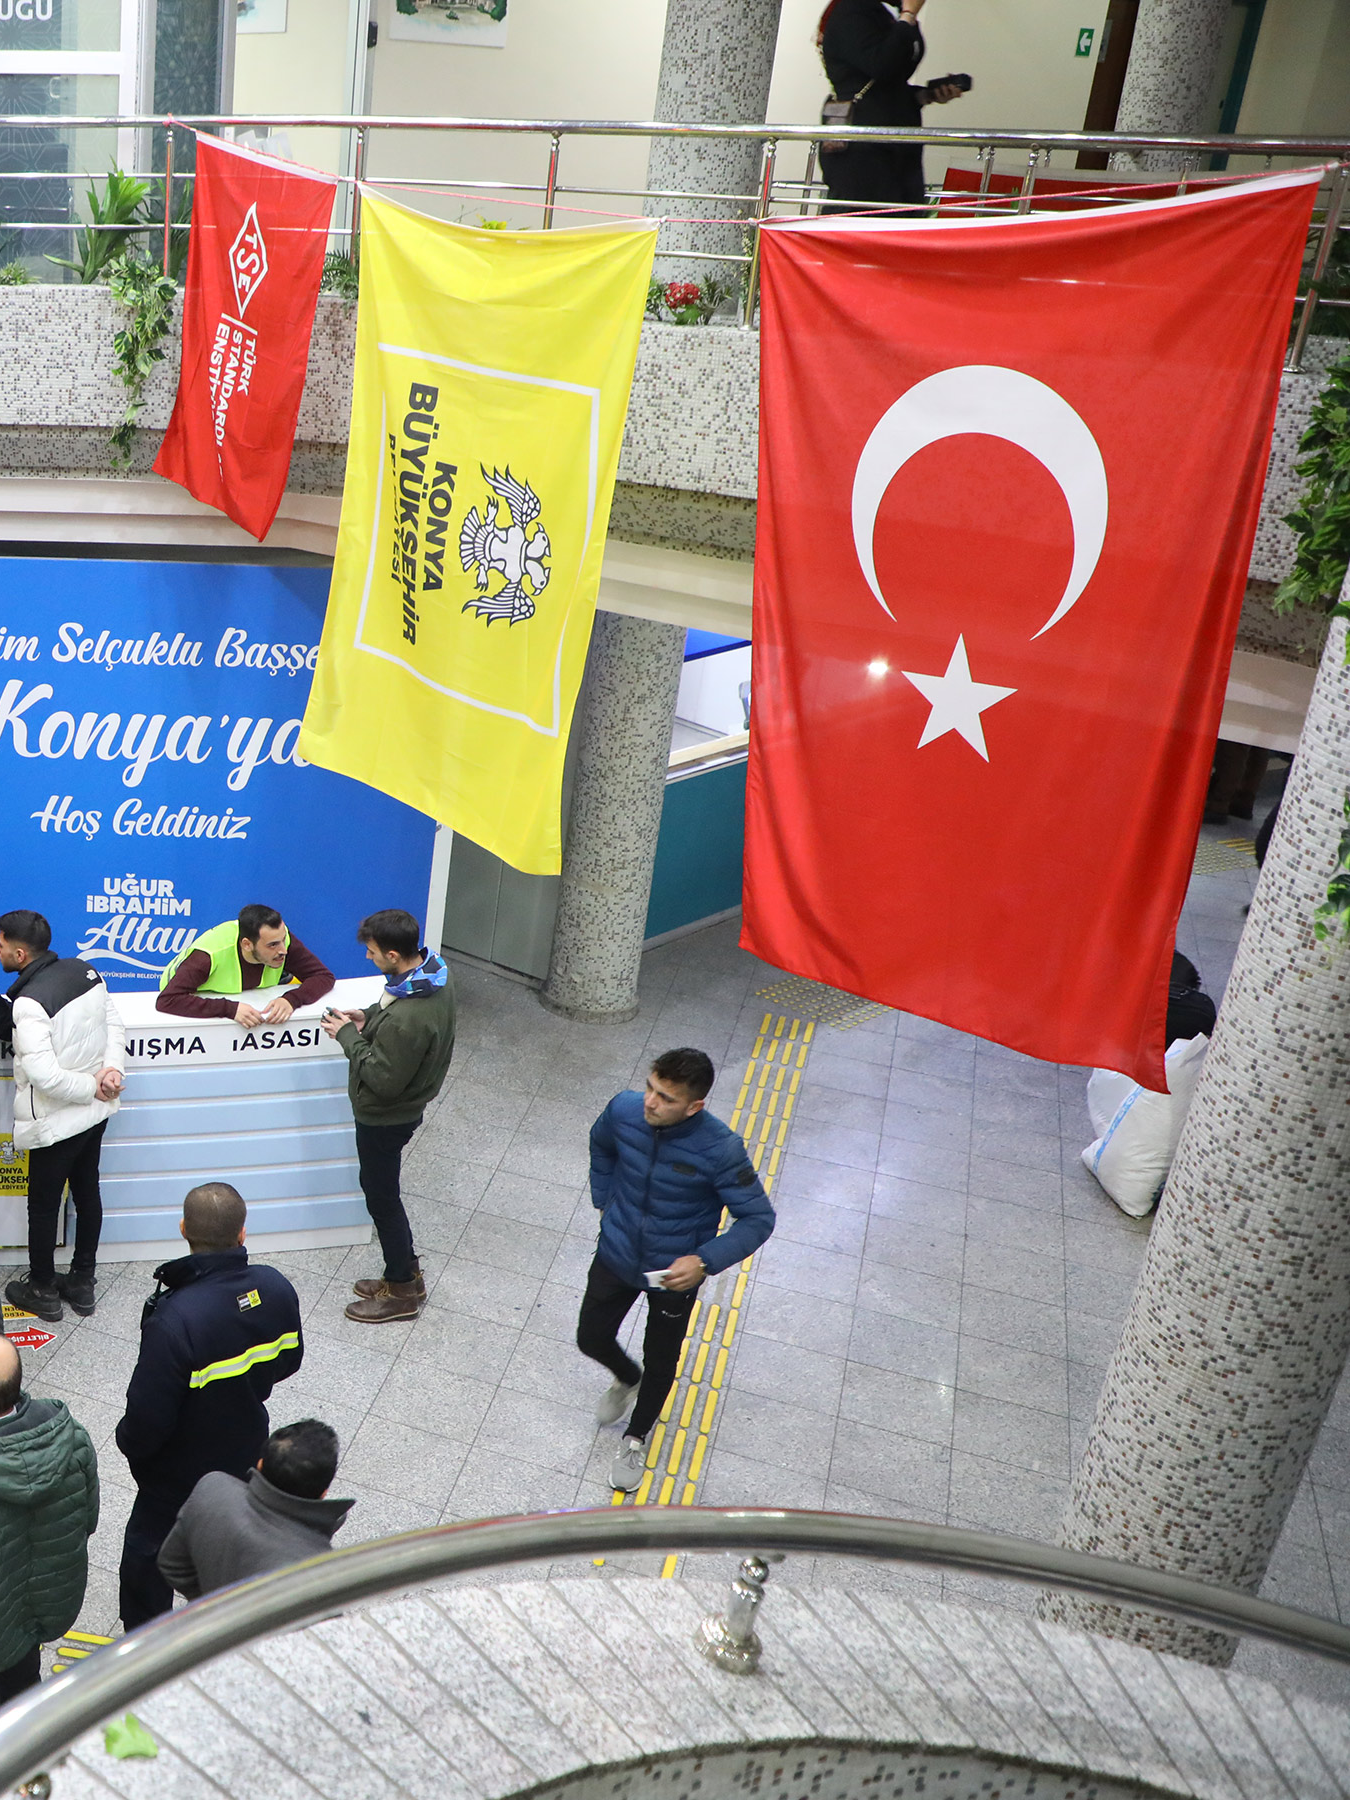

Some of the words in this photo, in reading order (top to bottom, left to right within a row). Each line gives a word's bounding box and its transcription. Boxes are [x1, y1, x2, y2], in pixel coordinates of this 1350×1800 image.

[236, 232, 261, 295] TSE
[237, 338, 258, 396] TÜRK
[399, 382, 440, 646] BÜYÜKŞEHİR
[422, 460, 458, 591] KONYA
[51, 622, 204, 672] Selçuklu
[214, 627, 321, 678] Başşe
[30, 795, 102, 841] Hoş
[112, 798, 252, 840] Geldiniz
[85, 895, 192, 916] İBRAHİM
[103, 873, 175, 898] UĞUR
[232, 1027, 321, 1052] ASASI
[7, 1336, 26, 1344] GİŞ
